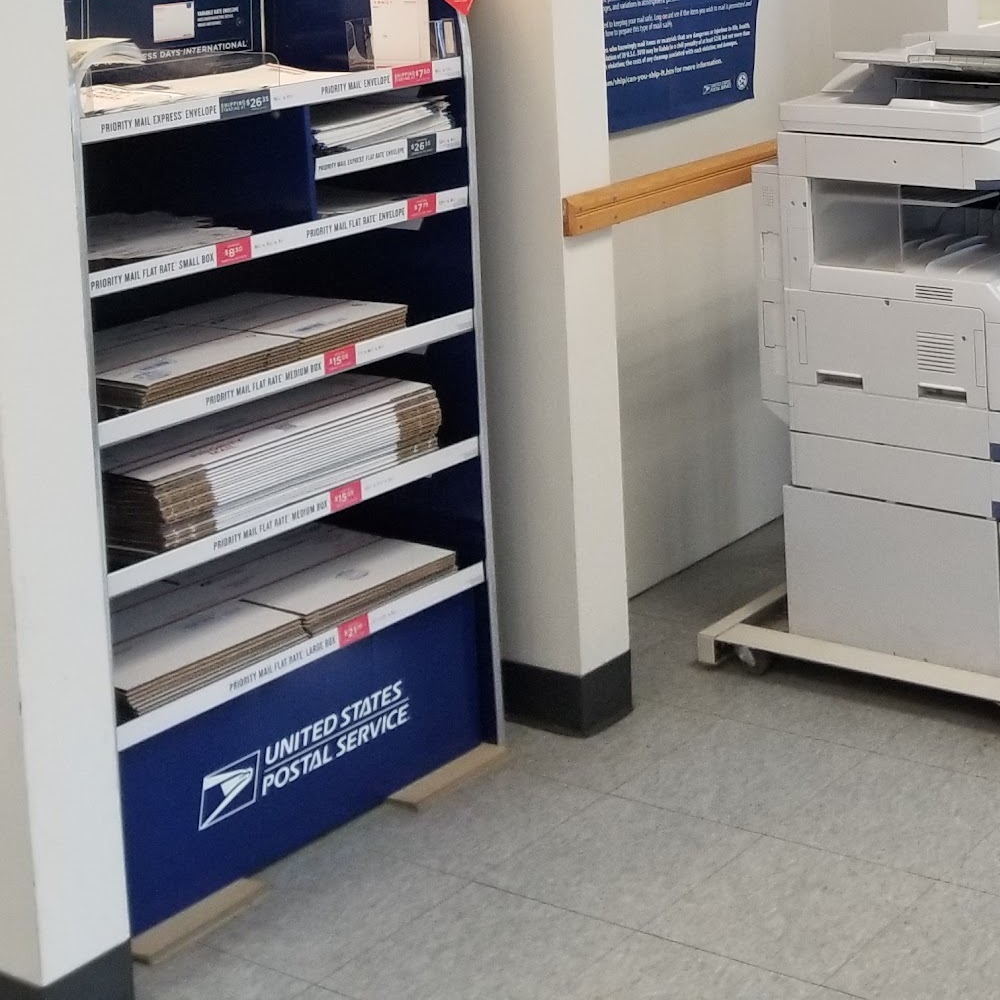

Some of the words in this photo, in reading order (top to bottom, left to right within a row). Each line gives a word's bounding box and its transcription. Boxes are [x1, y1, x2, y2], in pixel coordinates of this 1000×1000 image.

[160, 49, 181, 59] DAYS
[183, 40, 248, 57] INTERNATIONAL
[321, 83, 347, 95] PRIORITY
[348, 80, 361, 90] MAIL
[364, 75, 391, 88] ENVELOPE
[101, 119, 132, 133] PRIORITY
[134, 115, 150, 127] MAIL
[153, 110, 182, 125] EXPRESS
[185, 104, 217, 119] ENVELOPE
[306, 226, 332, 239] PRIORITY
[334, 222, 347, 232] MAIL
[349, 218, 361, 228] FLAT
[362, 215, 376, 225] RATE
[379, 207, 405, 221] ENVELOPE
[90, 276, 122, 291] PRIORITY
[124, 271, 140, 283] MAIL
[142, 267, 157, 279] FLAT
[159, 264, 174, 274] RATE
[178, 257, 200, 270] SMALL
[201, 252, 214, 264] BOX
[205, 390, 234, 406] PRIORITY
[236, 385, 251, 396] MAIL
[252, 379, 266, 391] FLAT
[267, 376, 281, 387] RATE
[285, 366, 309, 381] MEDIUM
[310, 362, 322, 374] BOX
[213, 533, 241, 550] PRIORITY
[243, 527, 258, 539] MAIL
[259, 520, 272, 533] FLAT
[274, 516, 288, 527] RATE
[291, 506, 315, 521] MEDIUM
[316, 500, 327, 512] BOX
[229, 674, 257, 691] PRIORITY
[258, 667, 272, 679] MAIL
[274, 660, 287, 671] FLAT
[306, 643, 323, 657] LARGE
[325, 636, 336, 648] BOX
[265, 712, 338, 765] UNITED
[340, 679, 403, 728] STATES
[261, 752, 334, 797] POSTAL
[336, 703, 410, 758] SERVICE
